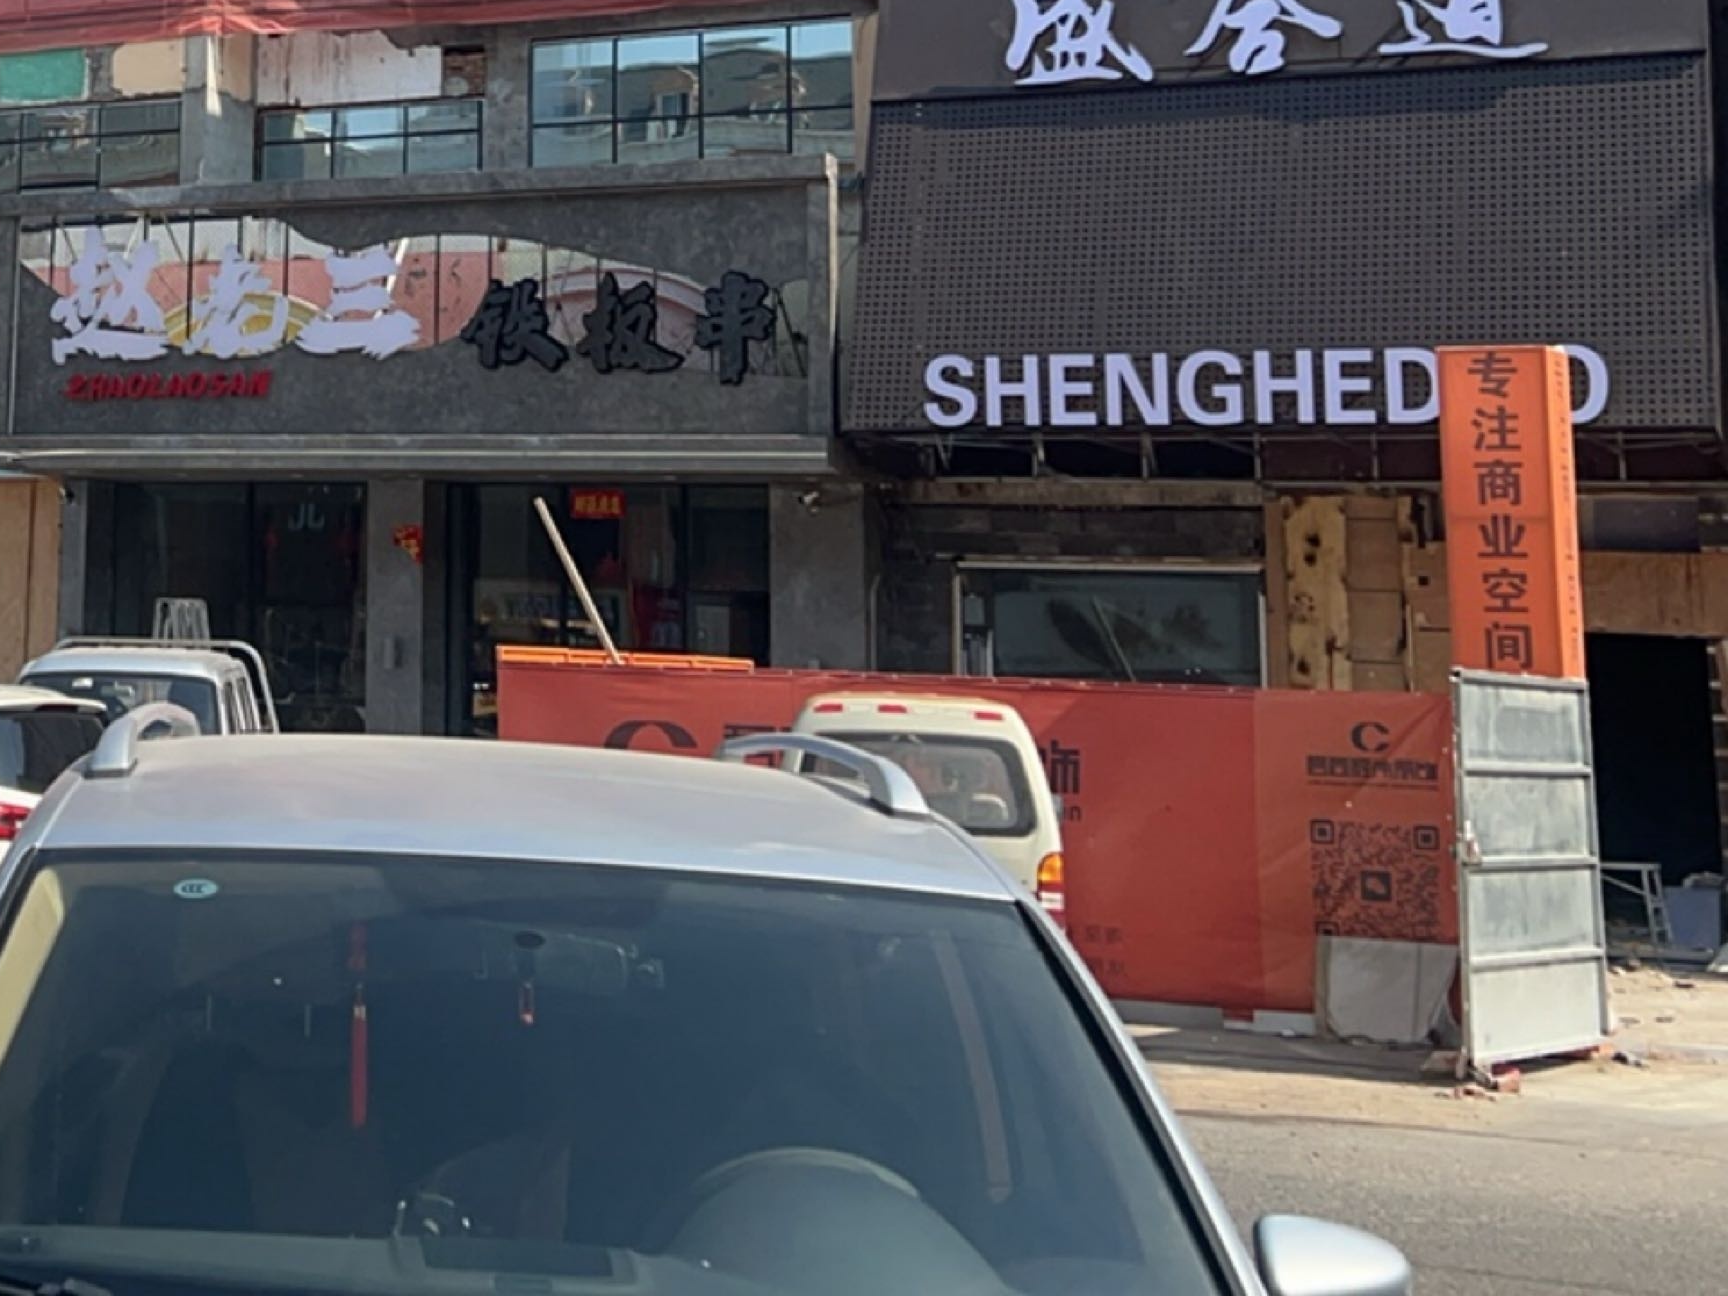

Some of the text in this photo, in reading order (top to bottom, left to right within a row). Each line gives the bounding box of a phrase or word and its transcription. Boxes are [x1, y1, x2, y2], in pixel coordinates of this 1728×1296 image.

[463, 270, 775, 385] 铁板串
[923, 344, 1610, 427] SHENGHEDO
[1467, 351, 1532, 670] 专注商业空间
